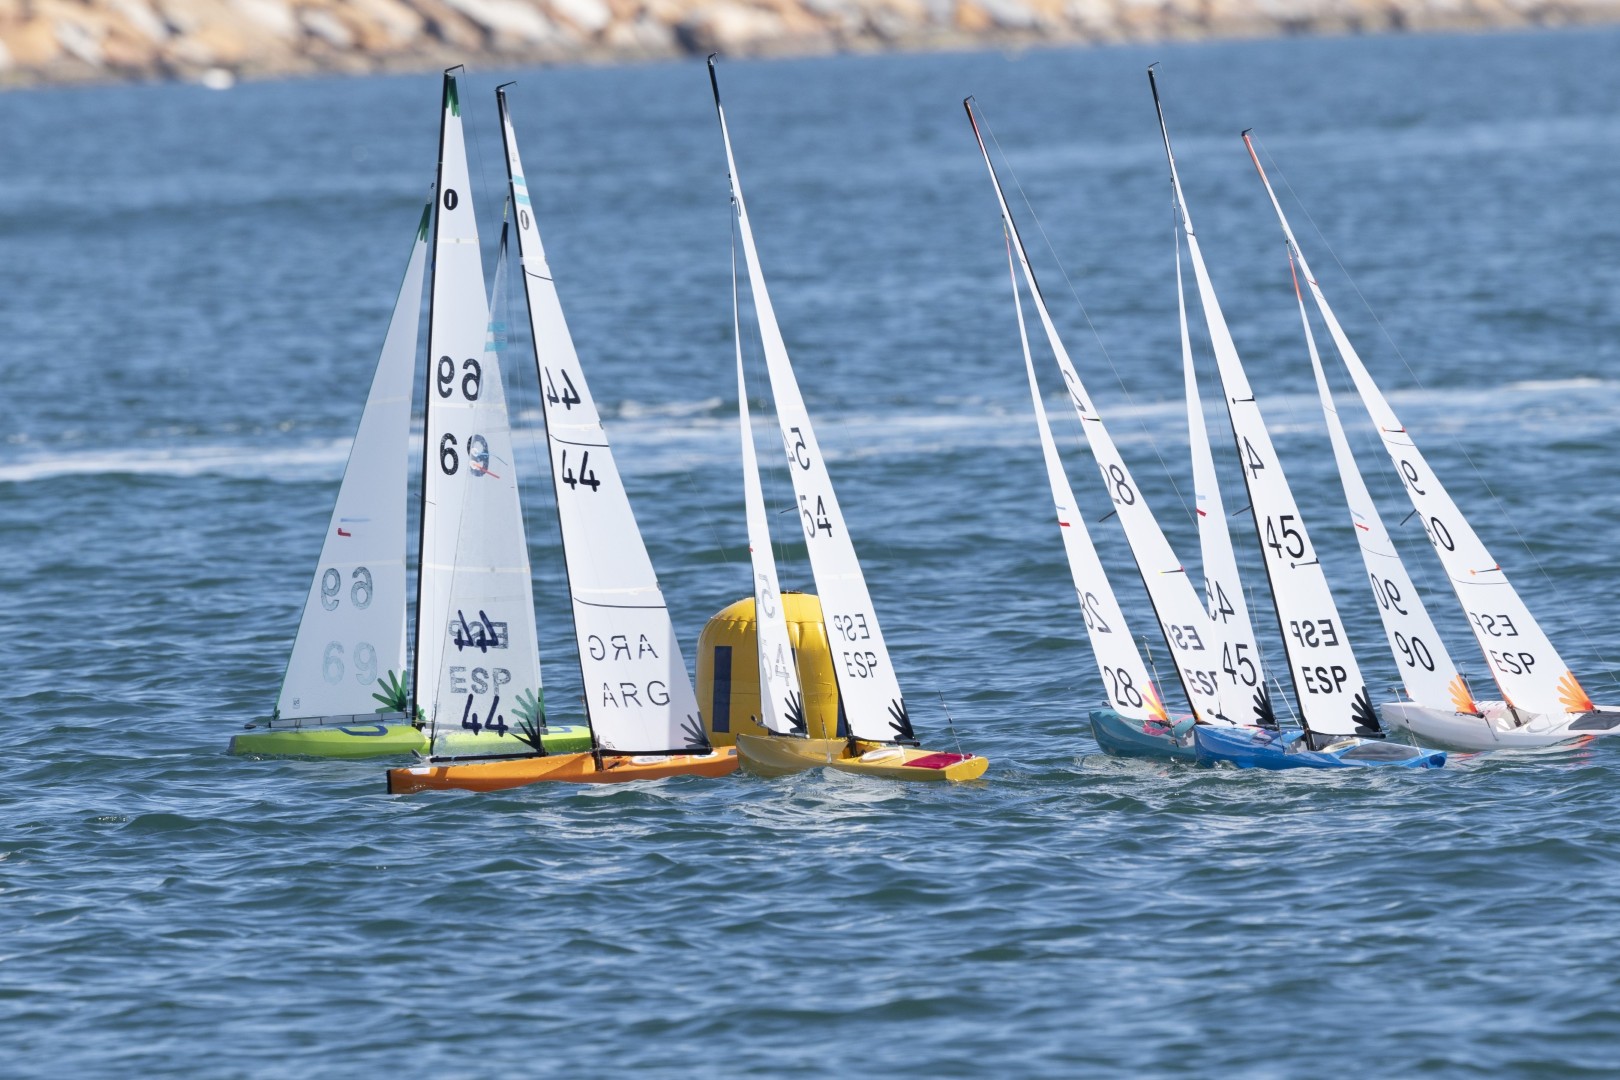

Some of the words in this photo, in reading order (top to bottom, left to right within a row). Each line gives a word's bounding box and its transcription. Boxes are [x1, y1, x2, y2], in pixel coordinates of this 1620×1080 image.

[443, 188, 459, 211] 0
[520, 209, 530, 231] 0
[439, 432, 490, 478] 69
[562, 449, 601, 492] 44
[799, 494, 833, 538] 54
[1266, 515, 1304, 559] 45
[322, 640, 378, 686] 69
[842, 652, 878, 679] ESP
[1222, 641, 1258, 687] 45
[1394, 631, 1436, 672] 90
[1489, 650, 1536, 675] ESP
[449, 666, 512, 697] ESP
[602, 680, 671, 708] ARG
[1103, 665, 1144, 708] 28
[1301, 665, 1348, 694] ESP
[462, 693, 509, 738] 44
